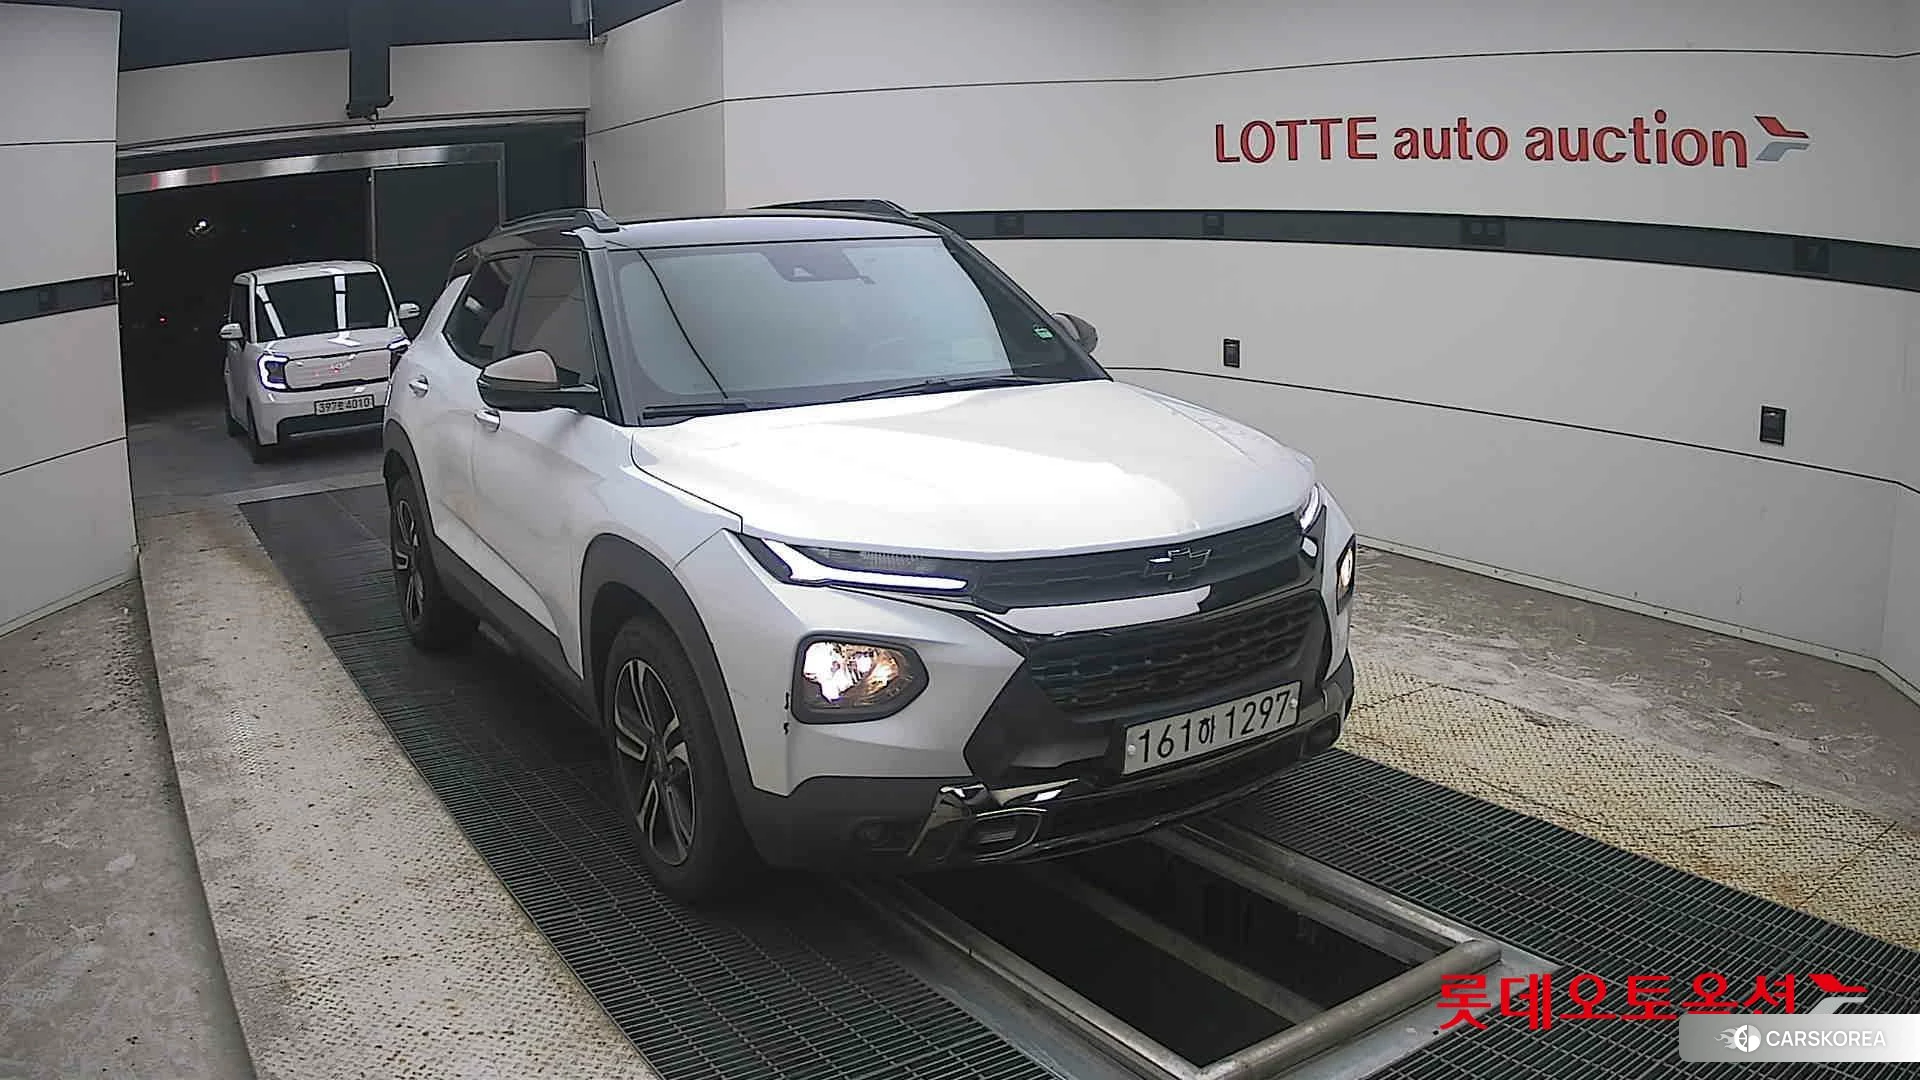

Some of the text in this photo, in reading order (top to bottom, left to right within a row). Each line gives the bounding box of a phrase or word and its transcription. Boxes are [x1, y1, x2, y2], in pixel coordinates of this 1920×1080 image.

[1214, 109, 1748, 168] LOTTE auto auction
[1138, 690, 1291, 763] 161하 1297
